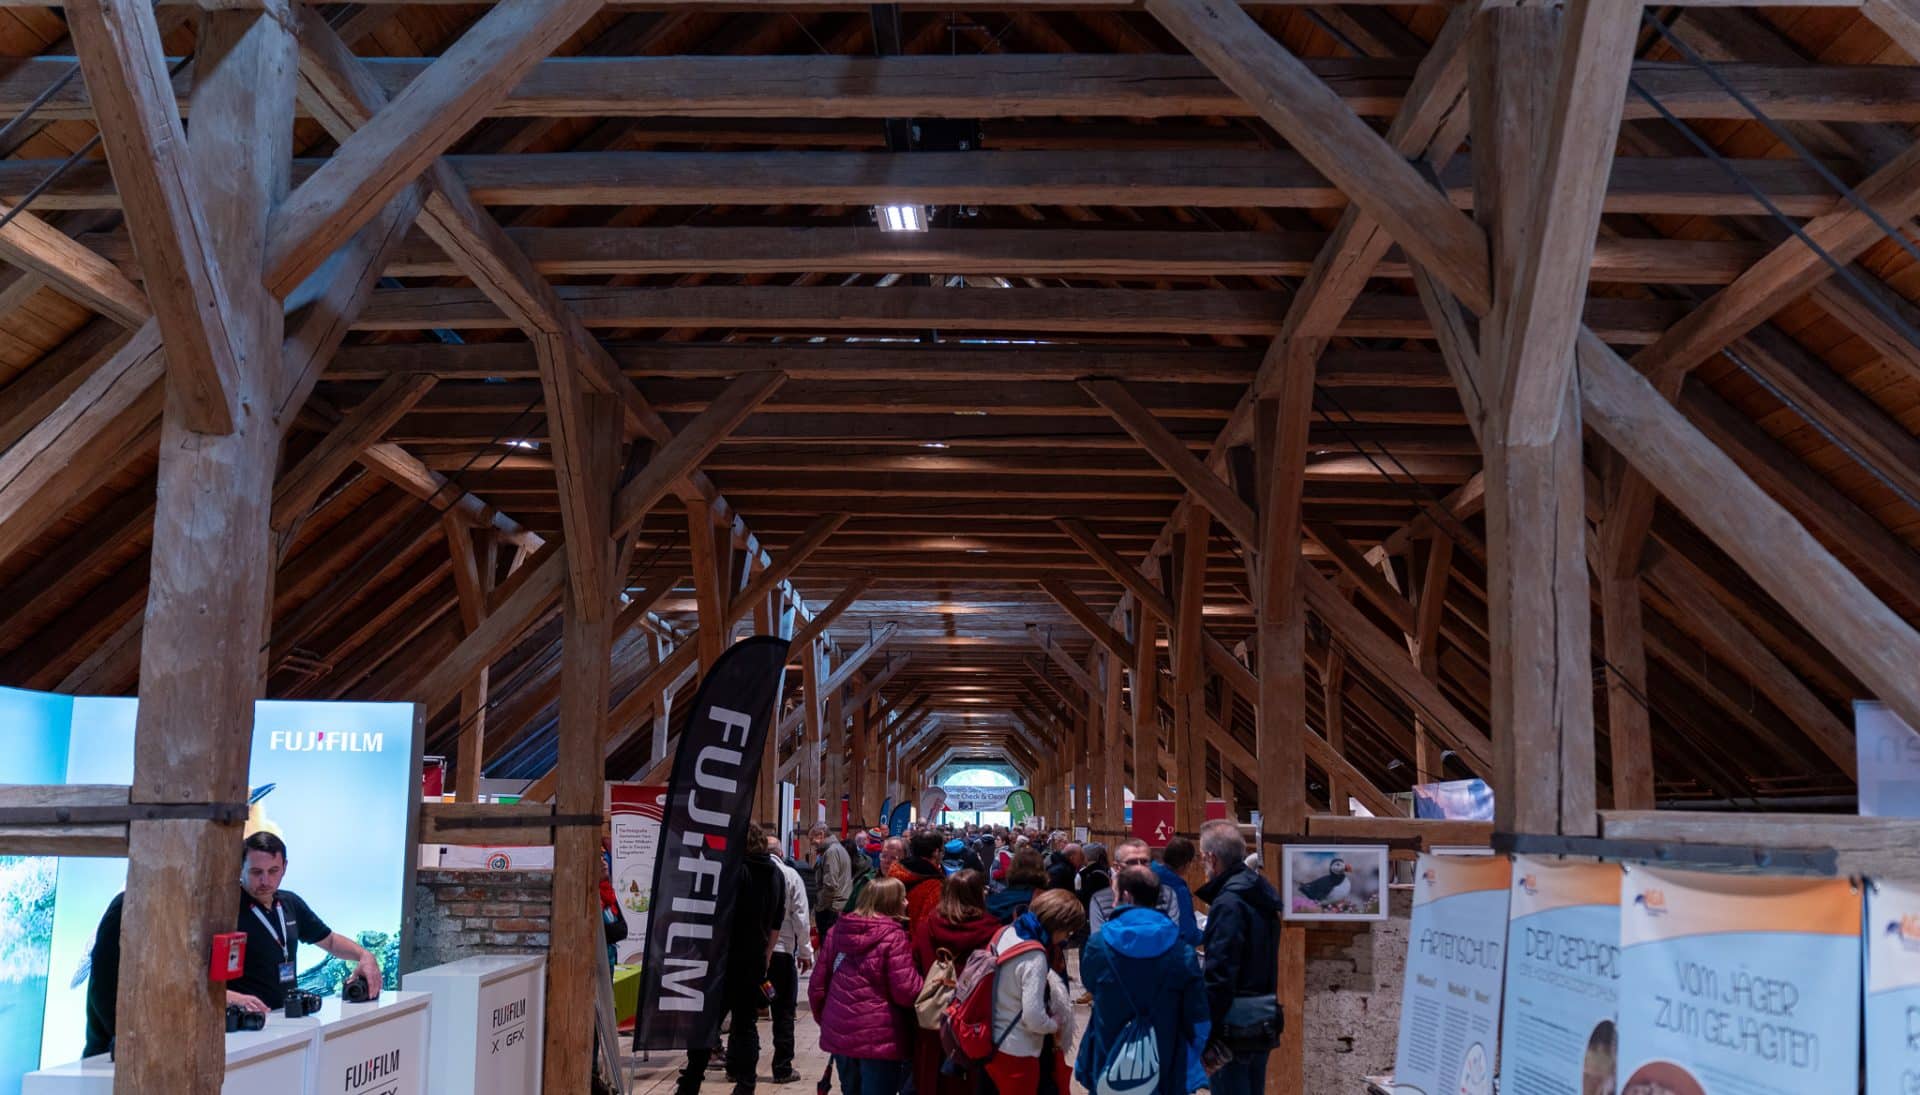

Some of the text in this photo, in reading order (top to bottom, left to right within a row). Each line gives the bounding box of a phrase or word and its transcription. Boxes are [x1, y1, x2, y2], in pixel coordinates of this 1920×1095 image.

[270, 730, 383, 753] FUJIFILM
[962, 792, 980, 800] Check
[658, 704, 752, 1012] FUJIFILM
[1525, 927, 1554, 960] DER
[1722, 963, 1800, 1018] JÄGER
[492, 998, 526, 1029] FUJIFILM
[492, 1028, 525, 1055] X GFX
[345, 1048, 401, 1092] FUJIFILM
